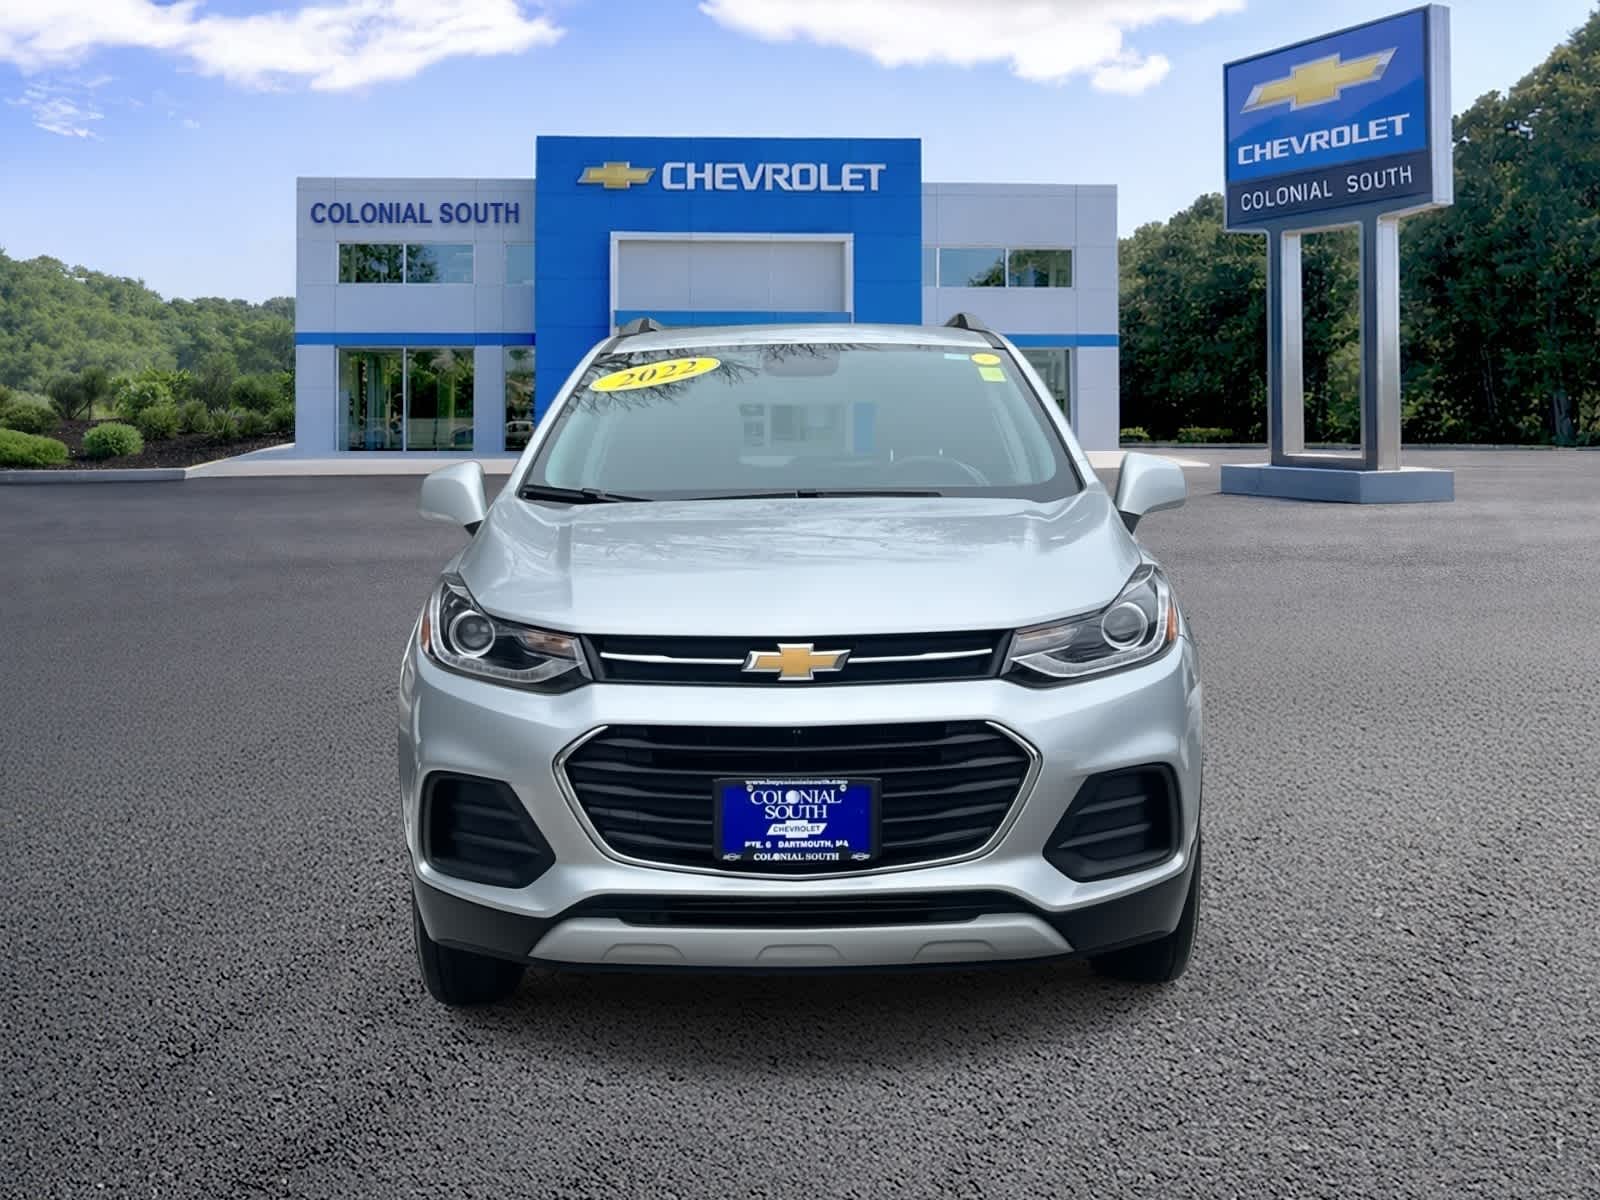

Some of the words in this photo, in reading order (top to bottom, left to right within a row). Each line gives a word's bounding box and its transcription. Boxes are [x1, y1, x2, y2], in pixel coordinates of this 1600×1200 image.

[1238, 113, 1410, 165] CHEVROLET
[662, 161, 887, 192] CHEVROLET
[1240, 180, 1333, 211] COLONIAL
[1346, 165, 1413, 193] SOUTH
[310, 202, 433, 225] COLONIAL
[439, 202, 520, 225] SOUTH
[618, 361, 697, 387] 2022
[750, 789, 842, 805] COLONIAL
[764, 804, 828, 820] SOUTH
[773, 825, 821, 833] CHEVROLET
[753, 852, 804, 861] COLONIAL
[805, 852, 840, 861] SOUTH
